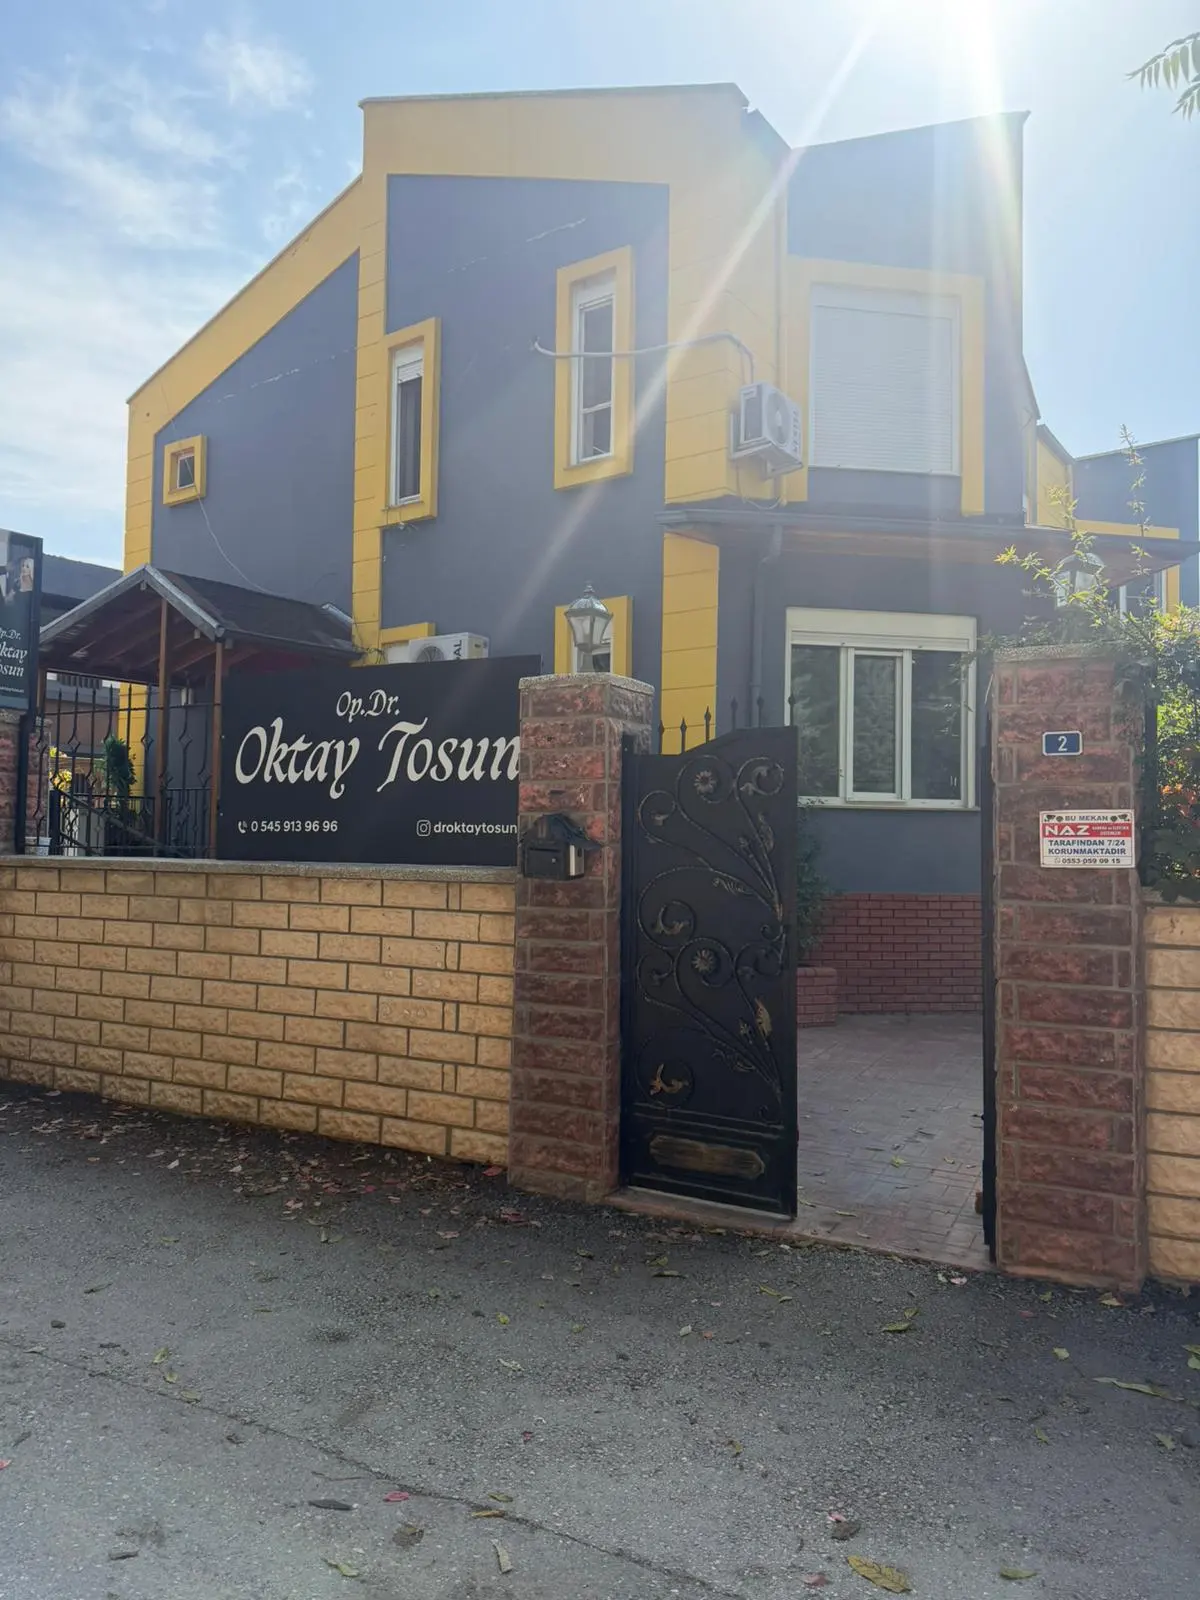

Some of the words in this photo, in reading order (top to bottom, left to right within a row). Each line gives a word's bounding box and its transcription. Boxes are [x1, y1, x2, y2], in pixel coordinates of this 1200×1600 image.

[0, 627, 21, 640] p.Dr.
[0, 641, 28, 664] ktay
[453, 639, 462, 660] AL
[335, 688, 400, 723] Op.Dr.
[1058, 735, 1068, 752] 2
[235, 716, 361, 800] Oktay
[376, 717, 520, 793] Tosun
[250, 820, 259, 832] 0
[260, 820, 281, 832] 545
[283, 820, 302, 832] 913
[304, 820, 320, 832] 96
[322, 820, 338, 832] 96
[433, 821, 518, 836] droktaytosun
[1045, 825, 1090, 836] NAZ
